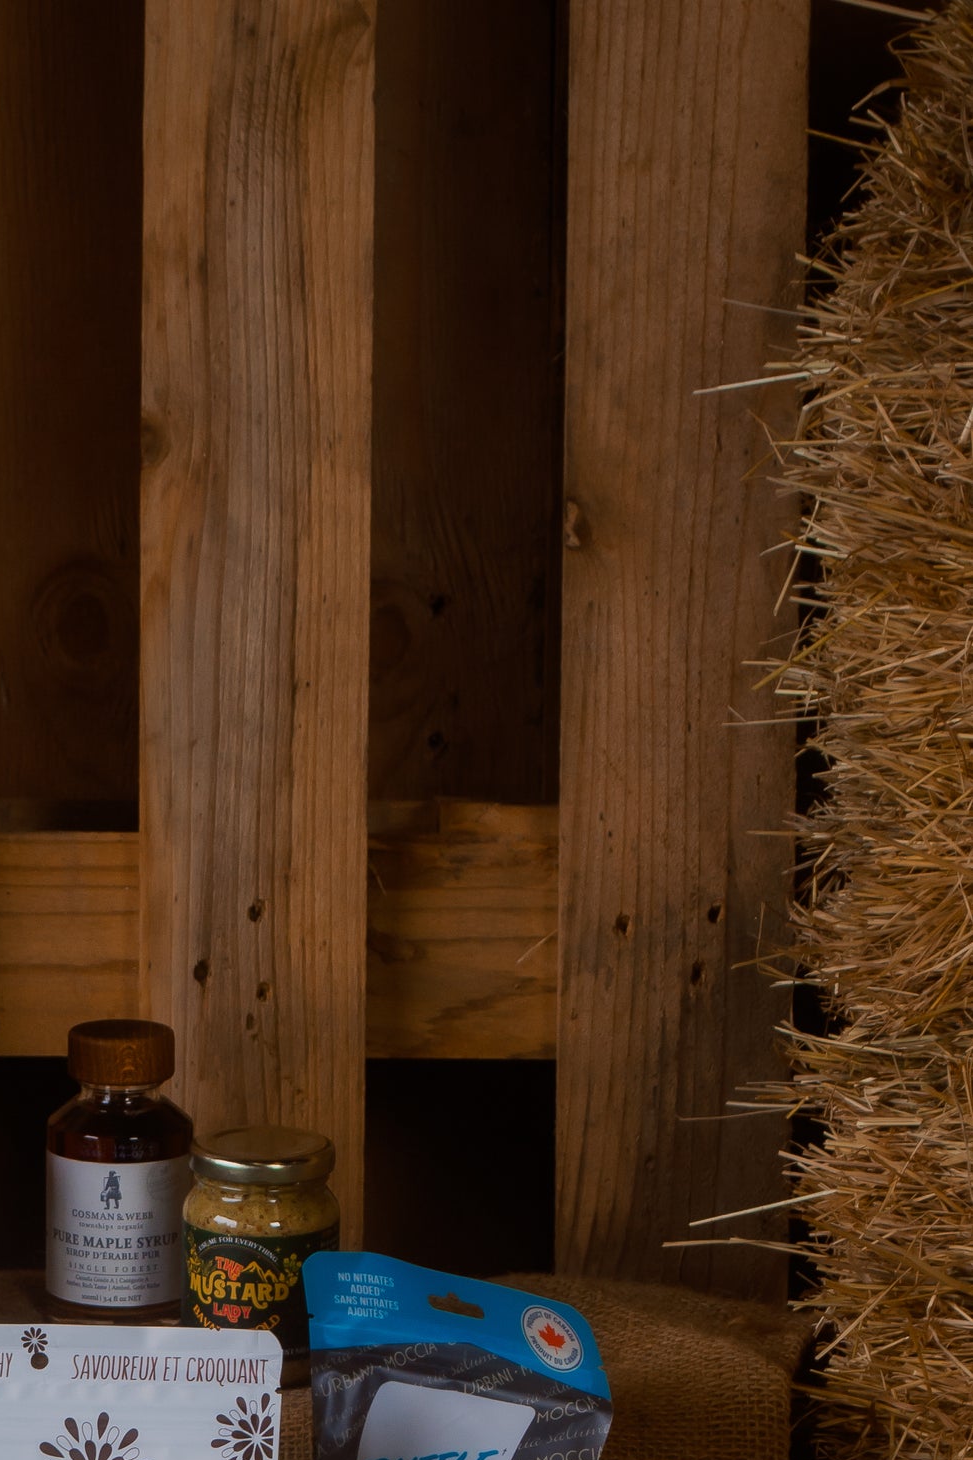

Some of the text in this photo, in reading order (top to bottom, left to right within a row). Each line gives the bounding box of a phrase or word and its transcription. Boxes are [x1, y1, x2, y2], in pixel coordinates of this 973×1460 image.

[72, 1208, 154, 1221] COSMAN & WEBB
[79, 1222, 143, 1231] townships organic
[52, 1228, 178, 1248] PURE MAPLE SYRUP
[235, 1237, 278, 1263] EVERYTHING
[66, 1246, 160, 1260] SIROP D'ÉRABLE PUR
[69, 1261, 159, 1272] SINGLE FOREST
[215, 1255, 245, 1281] THE
[190, 1270, 289, 1310] MUSTARD
[338, 1272, 395, 1288] NO NITRATES
[213, 1302, 252, 1323] LADY
[334, 1294, 399, 1311] SANS NITRATES
[553, 1317, 576, 1342] CANADA
[530, 1336, 553, 1361] PRODUIT
[71, 1354, 268, 1386] SAVOUREUX ET CROQUANT
[320, 1365, 374, 1397] URBANI
[384, 1343, 438, 1370] MOCCIA
[463, 1369, 514, 1396] URBANI
[536, 1397, 599, 1424] MOCCIA
